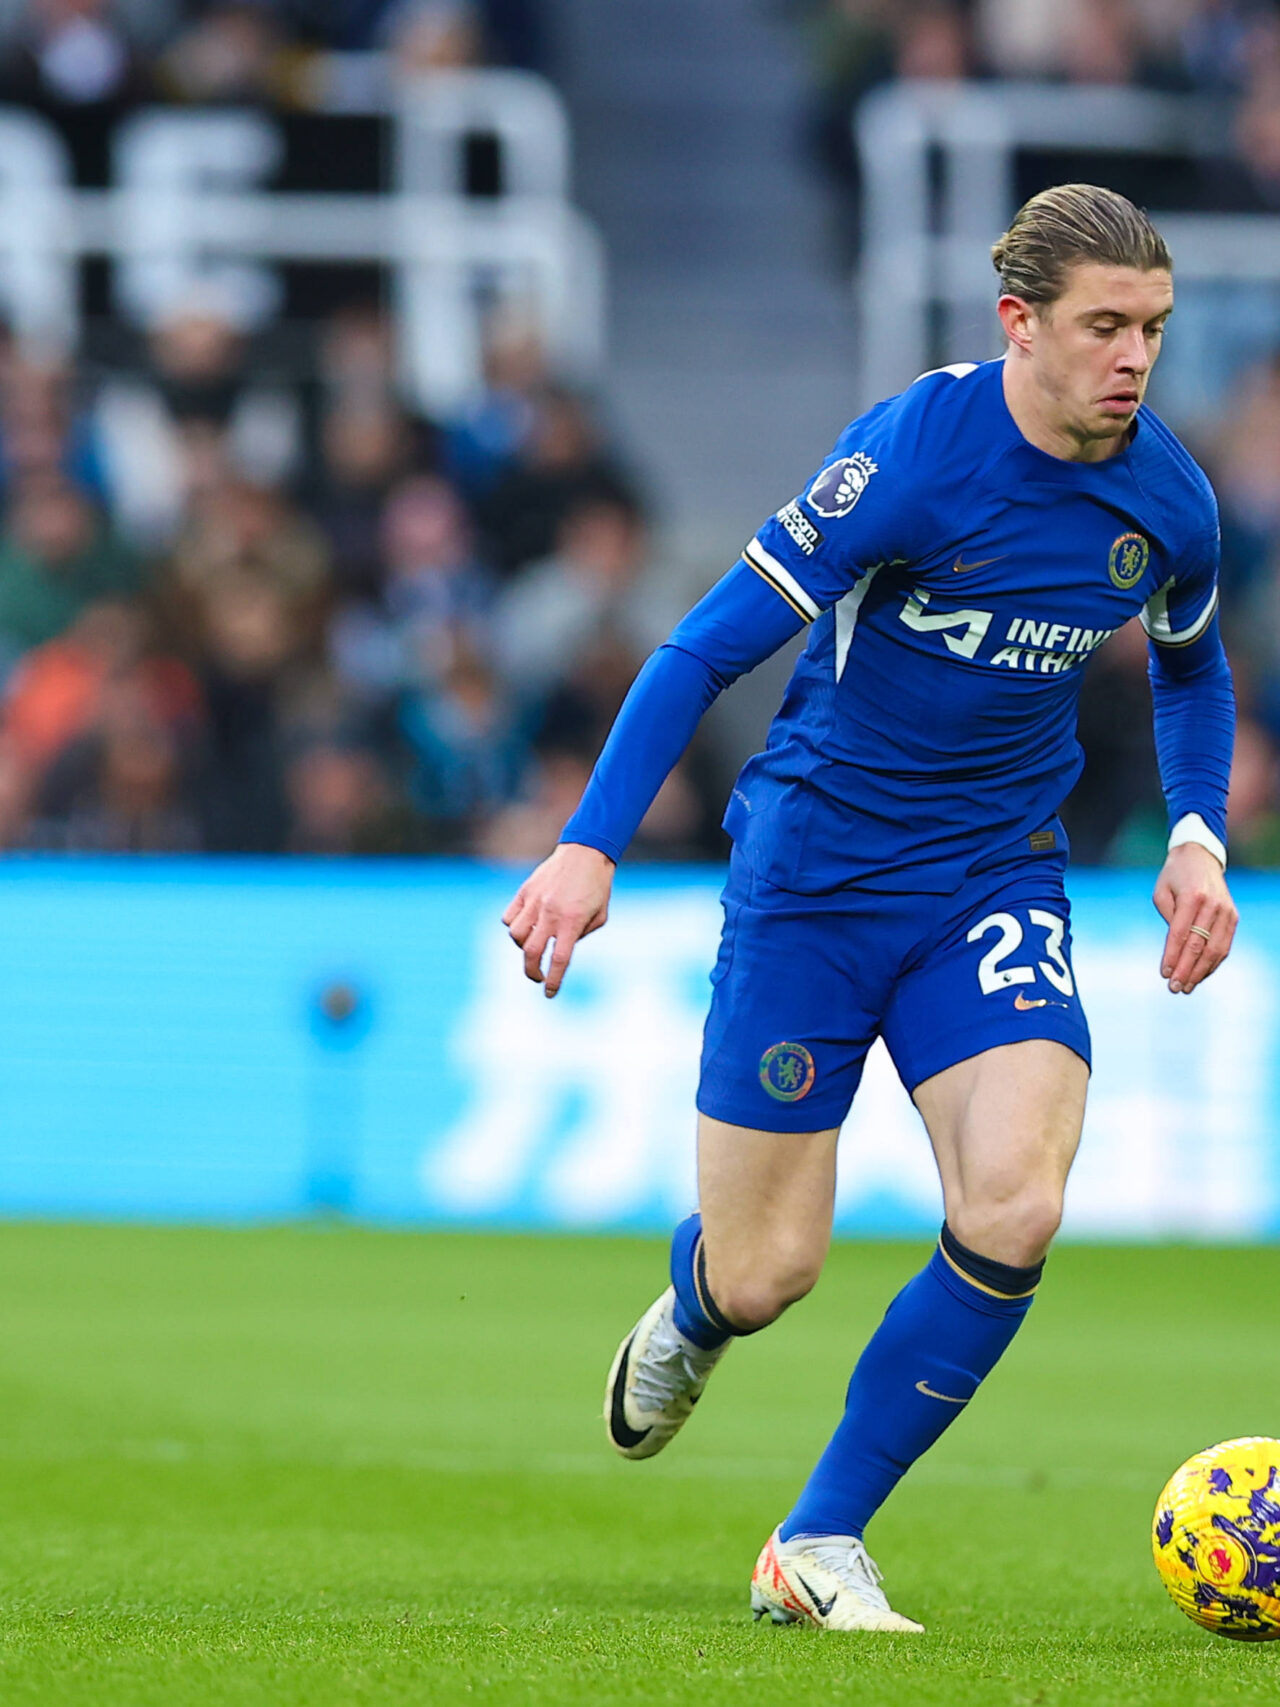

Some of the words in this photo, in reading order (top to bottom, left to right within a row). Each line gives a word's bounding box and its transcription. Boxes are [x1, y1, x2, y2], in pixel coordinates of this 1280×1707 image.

[1006, 617, 1119, 652] INFINI
[989, 646, 1088, 674] ATHL
[966, 908, 1075, 997] 23
